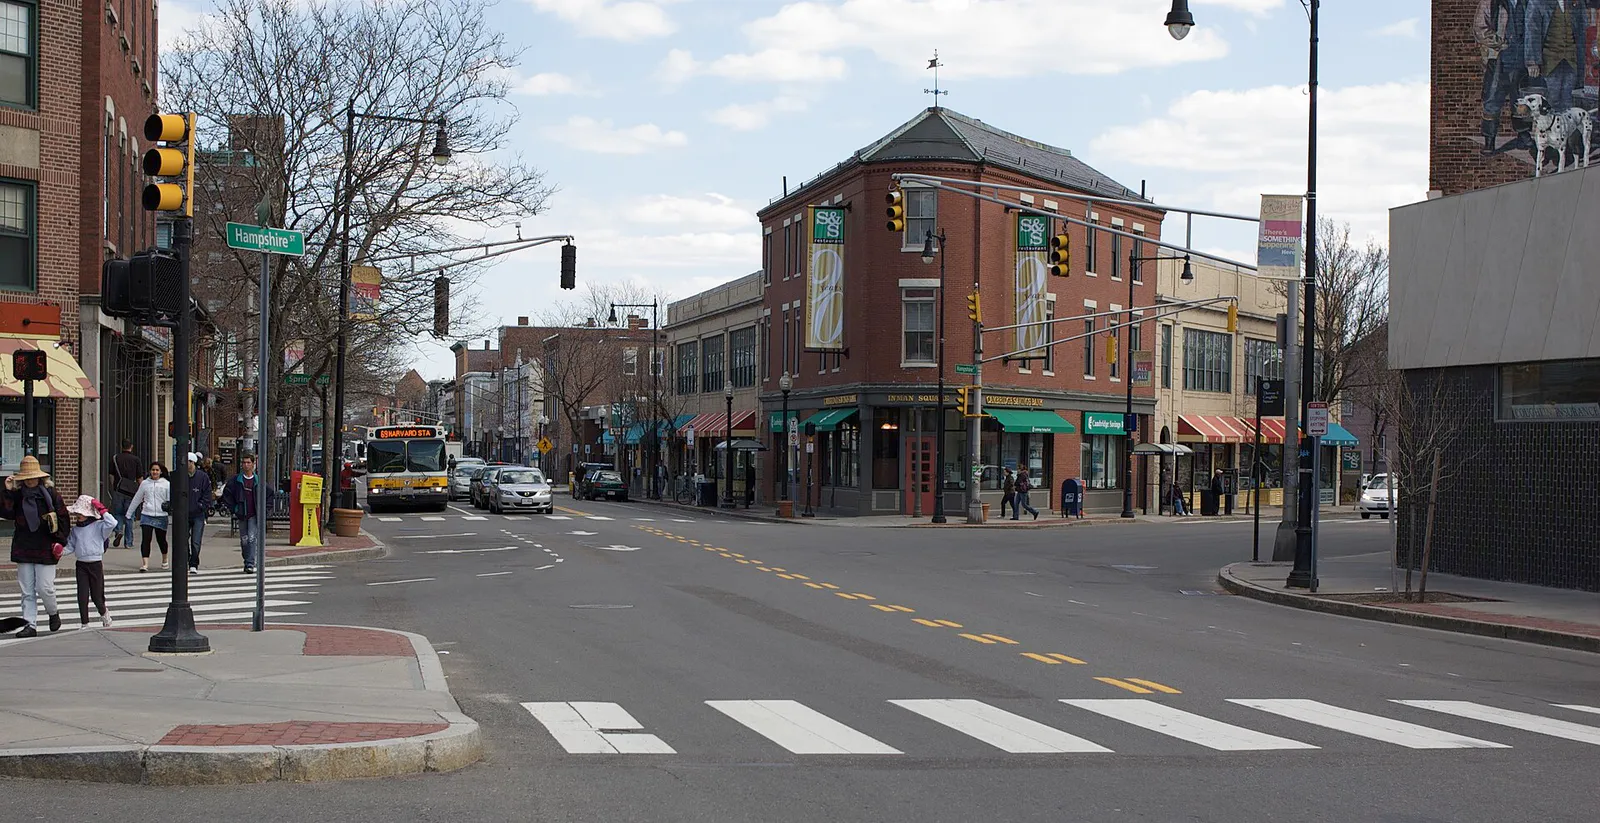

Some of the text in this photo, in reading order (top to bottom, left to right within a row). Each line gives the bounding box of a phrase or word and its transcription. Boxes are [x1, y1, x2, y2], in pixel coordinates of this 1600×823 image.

[235, 228, 288, 248] Hampshire
[289, 375, 330, 384] Sprineld
[388, 429, 417, 438] HARVARD
[417, 429, 431, 437] STA
